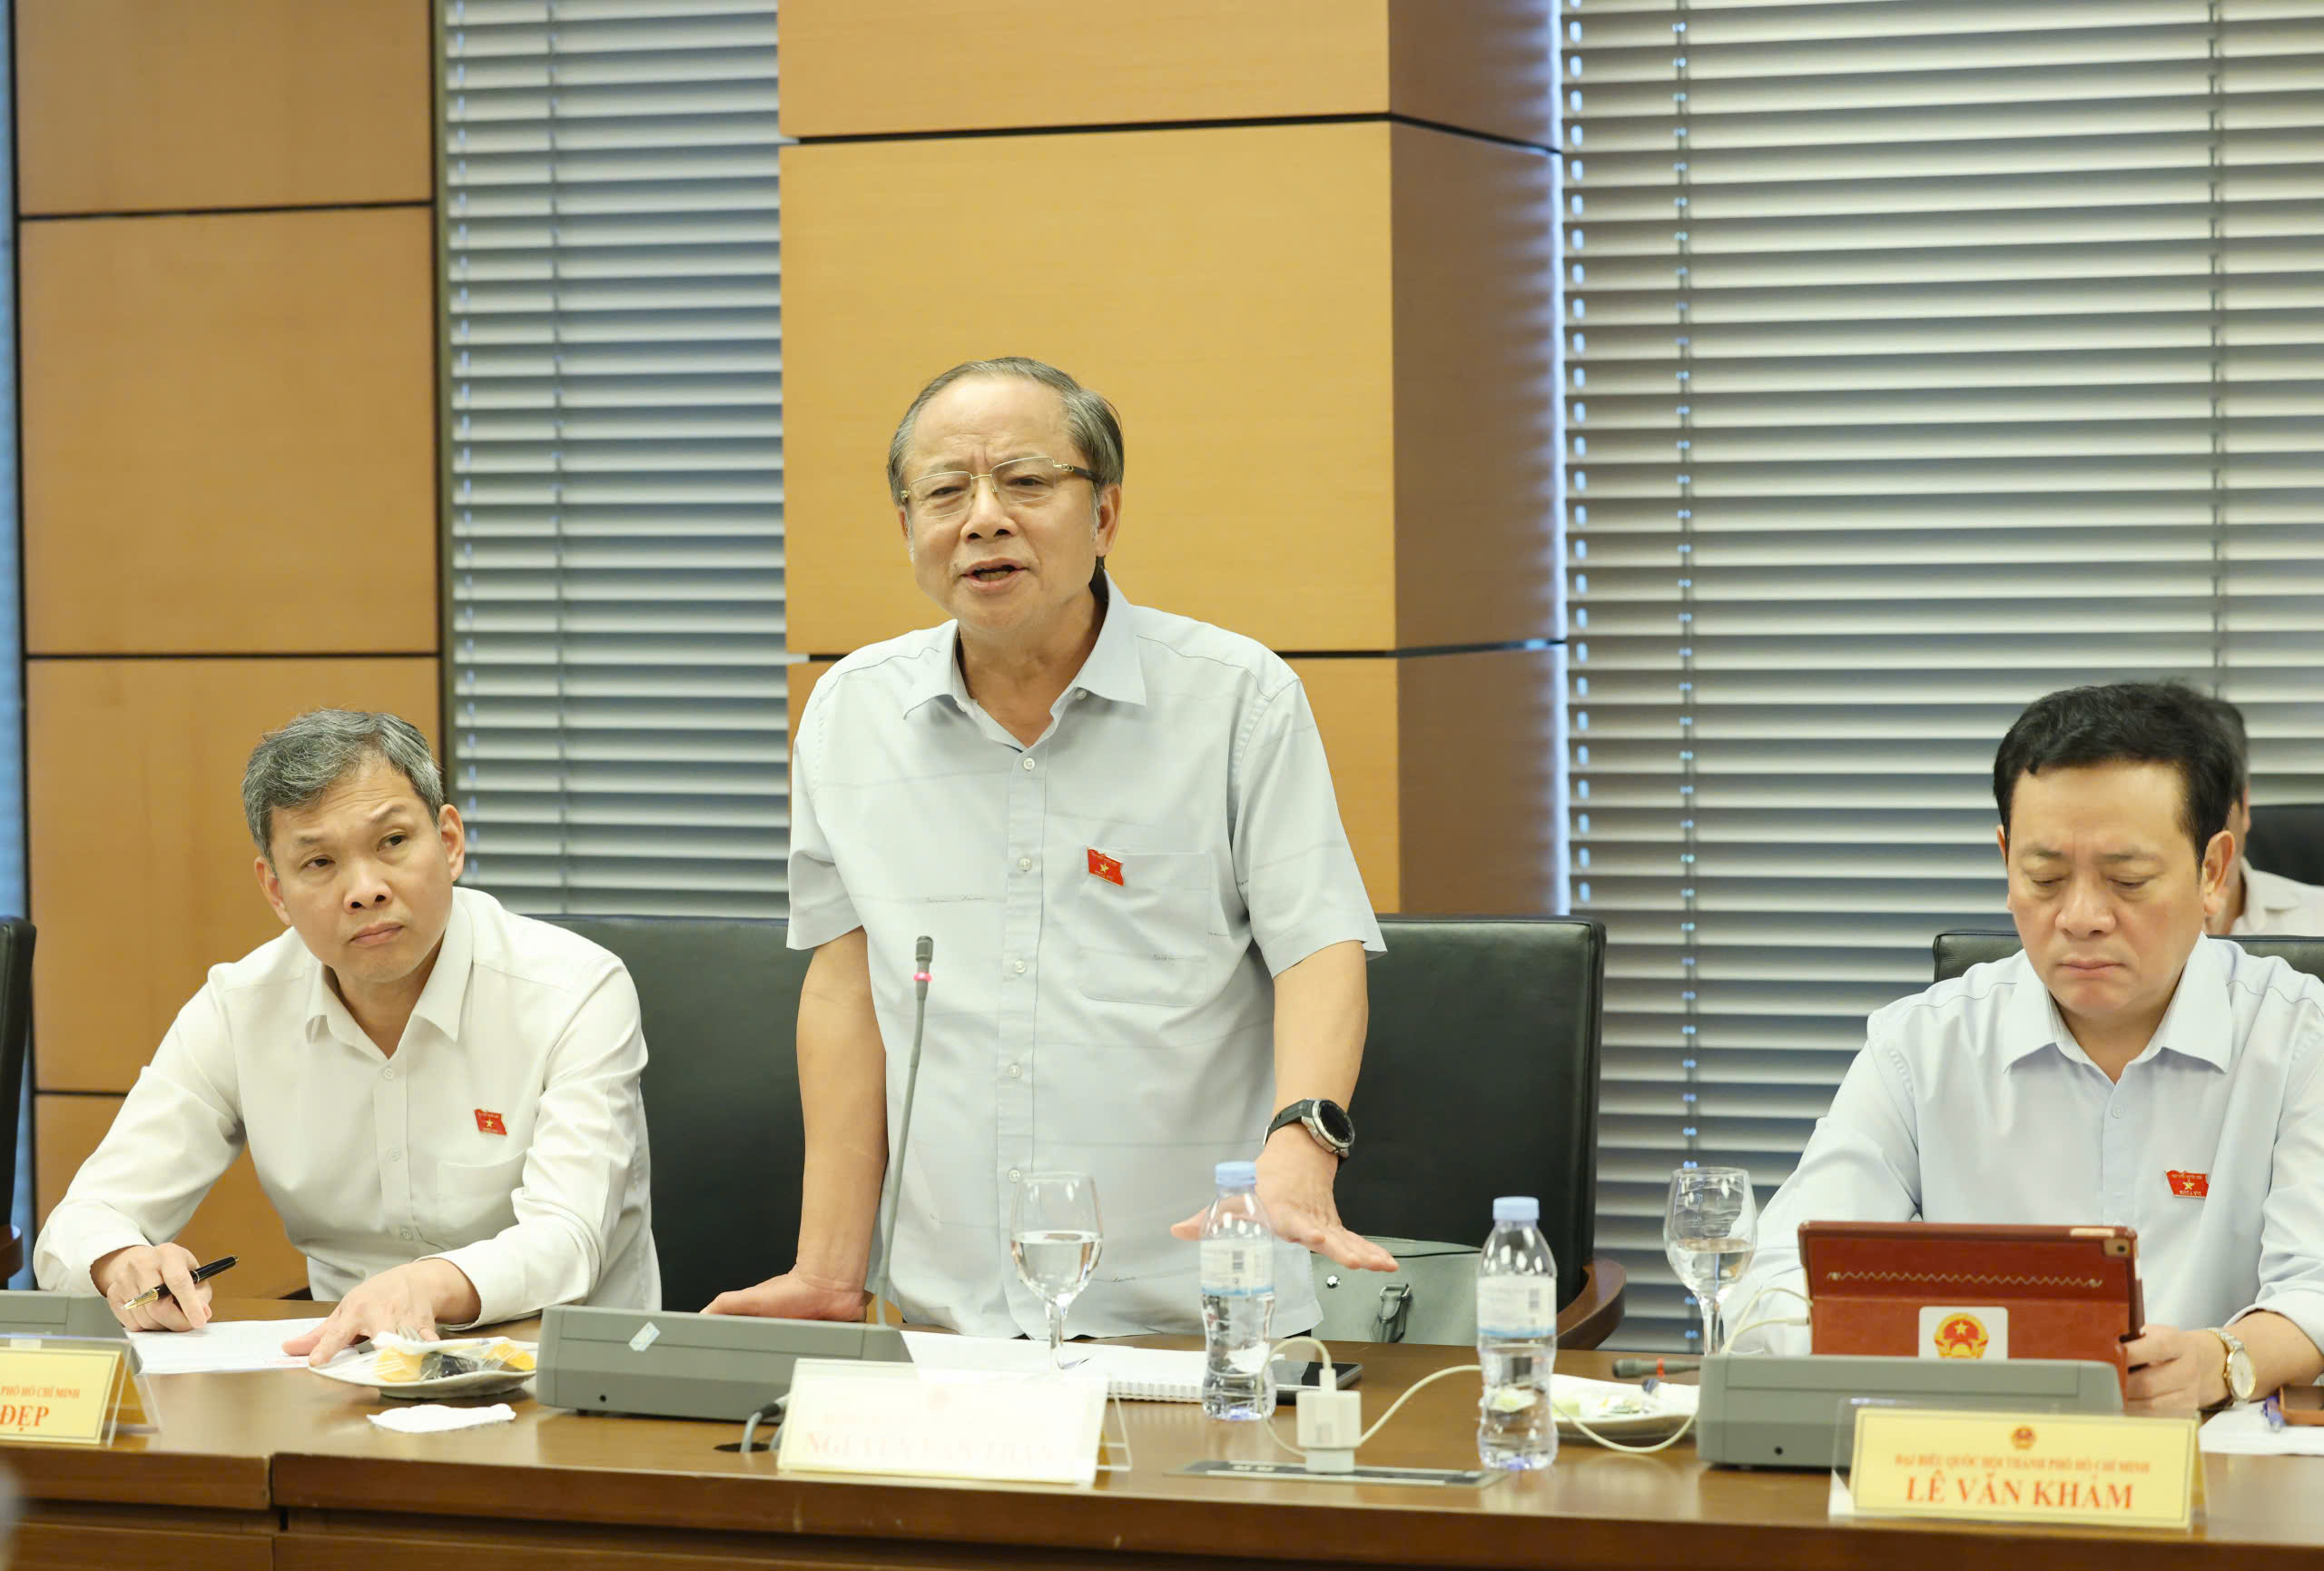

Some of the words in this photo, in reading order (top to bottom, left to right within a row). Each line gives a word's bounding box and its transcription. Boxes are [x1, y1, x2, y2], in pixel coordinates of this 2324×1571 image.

[55, 1387, 81, 1399] MINH
[1905, 1469, 1946, 1504] LÊ
[1955, 1472, 2024, 1505] VĂN
